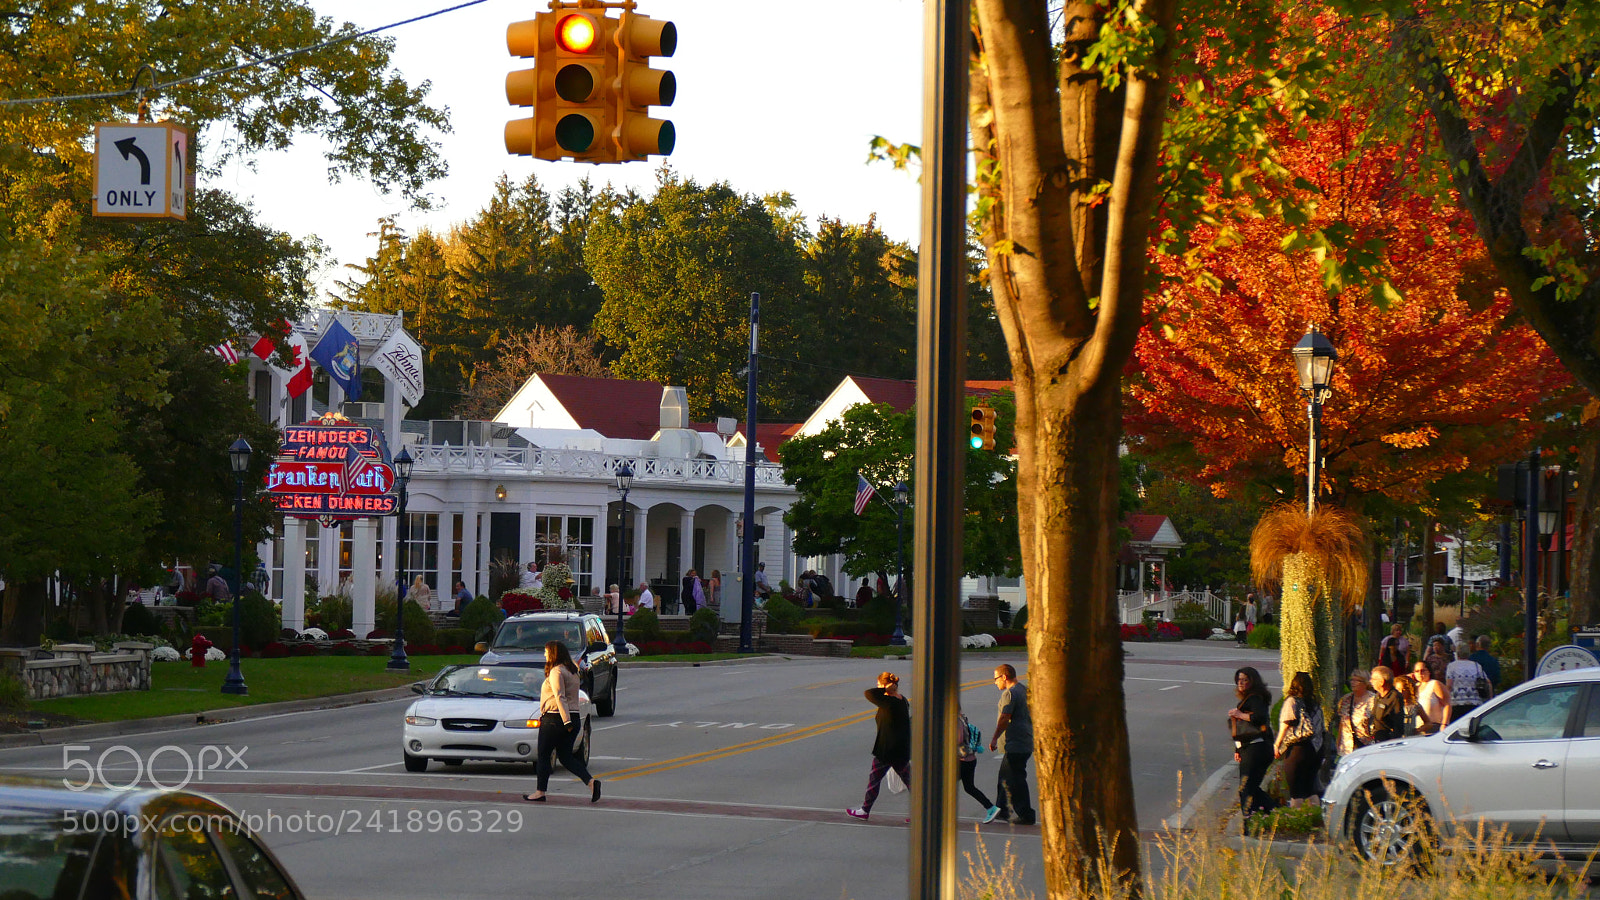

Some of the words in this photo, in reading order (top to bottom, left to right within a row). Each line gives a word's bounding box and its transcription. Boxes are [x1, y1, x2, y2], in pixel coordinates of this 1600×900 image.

[106, 190, 156, 206] ONLY
[287, 430, 368, 444] ZEHNDER'S
[298, 445, 349, 460] FAMOU
[267, 463, 387, 492] Frankenuth
[328, 495, 394, 511] DINNERS
[647, 720, 796, 730] ONLY
